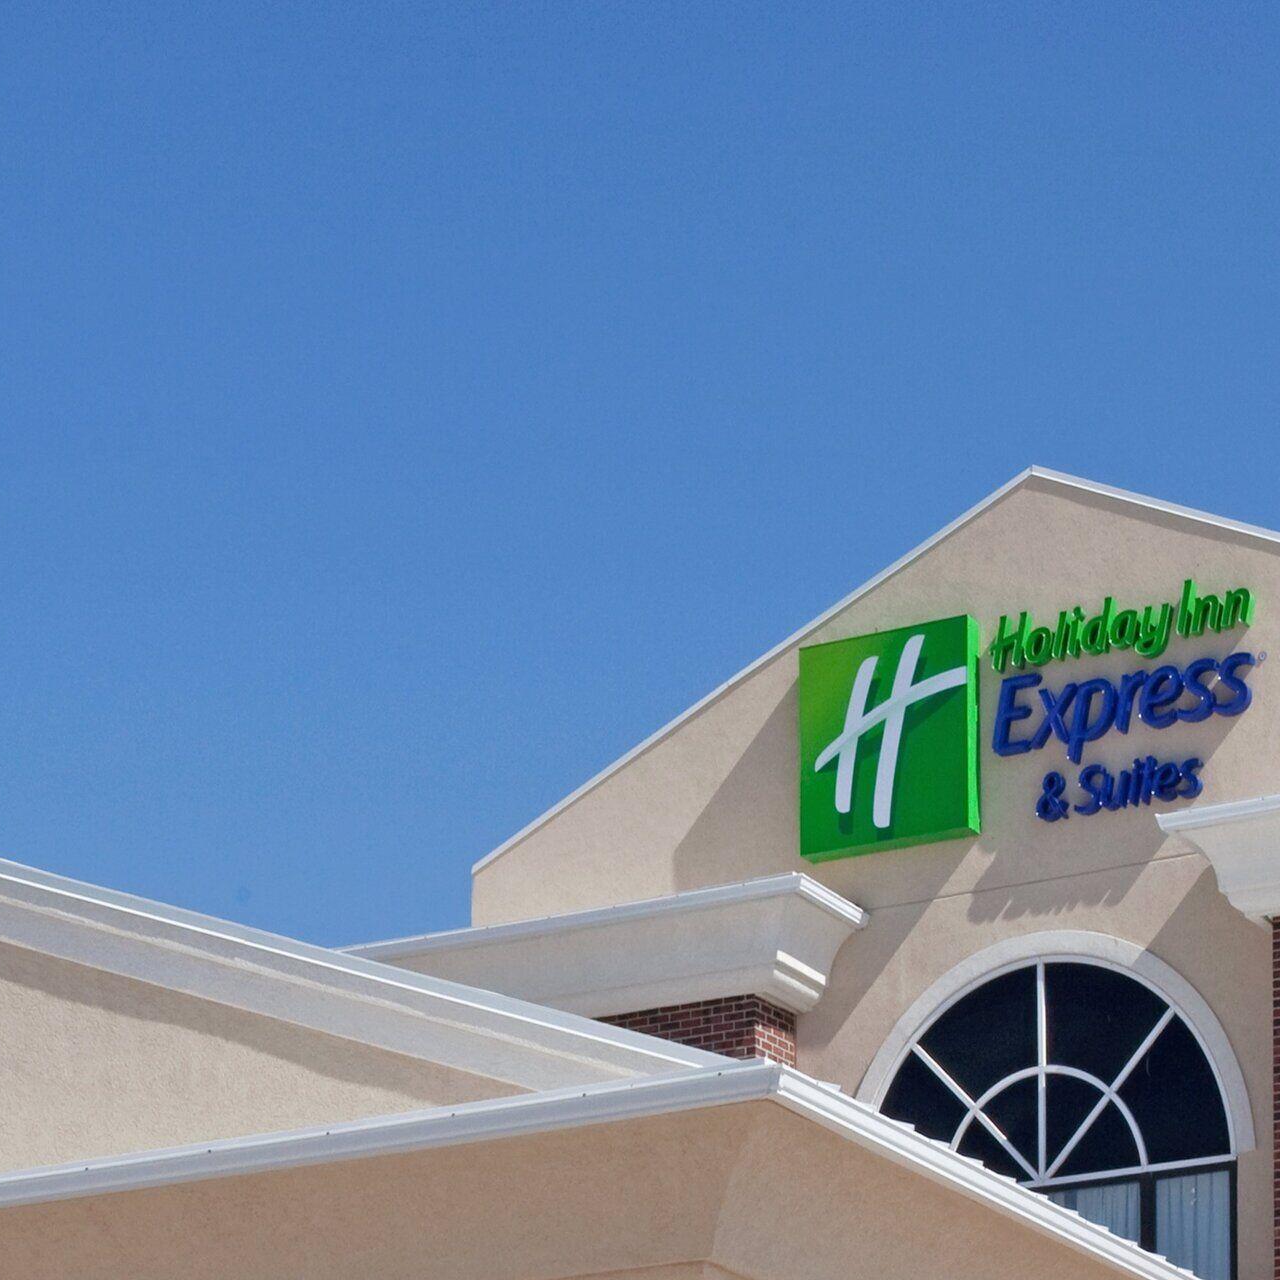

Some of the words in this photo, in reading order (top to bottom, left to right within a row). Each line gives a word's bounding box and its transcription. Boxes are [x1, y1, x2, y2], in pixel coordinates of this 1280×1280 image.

[989, 596, 1173, 674] Holiday
[1176, 578, 1255, 639] Inn
[992, 651, 1256, 765] Express
[1035, 771, 1069, 823] &
[1074, 755, 1204, 816] Suites
